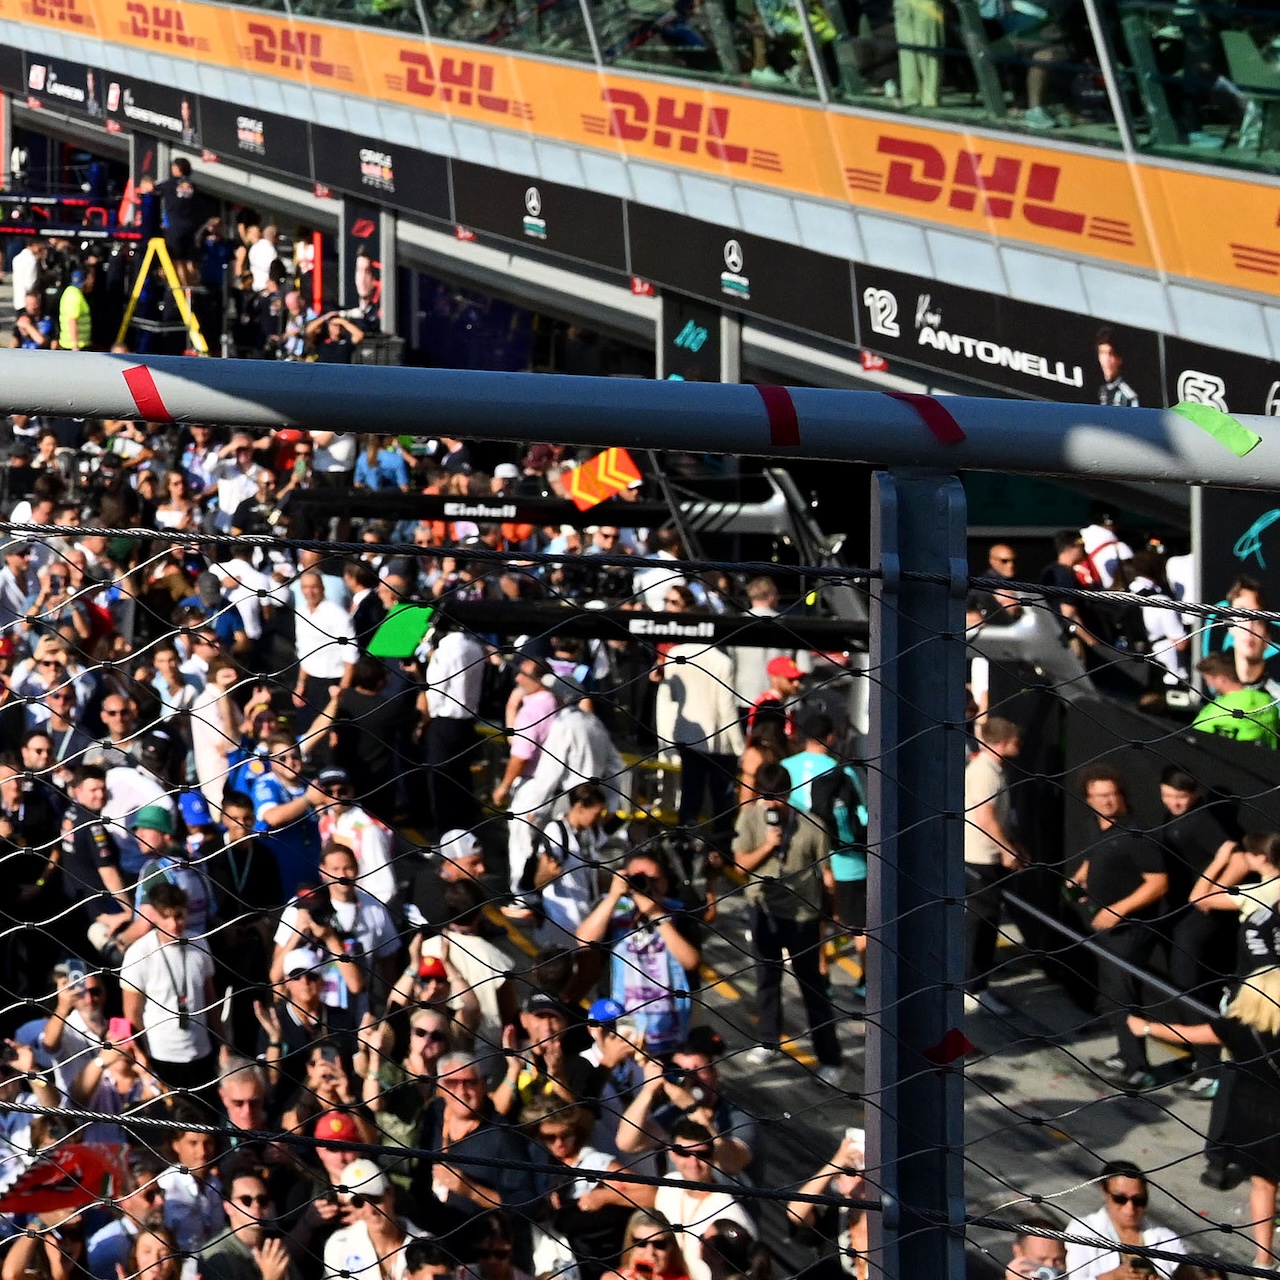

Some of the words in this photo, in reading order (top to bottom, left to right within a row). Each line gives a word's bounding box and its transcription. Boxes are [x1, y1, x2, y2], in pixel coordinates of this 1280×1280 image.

[126, 1, 196, 49] DHL
[248, 21, 335, 78] DHL
[399, 49, 510, 115] DHL
[601, 86, 750, 166] DHL
[877, 134, 1087, 236] DHL
[863, 286, 901, 338] 12
[918, 326, 1084, 389] ANTONELLI
[444, 502, 517, 519] Einhell
[628, 618, 716, 638] Einhell
